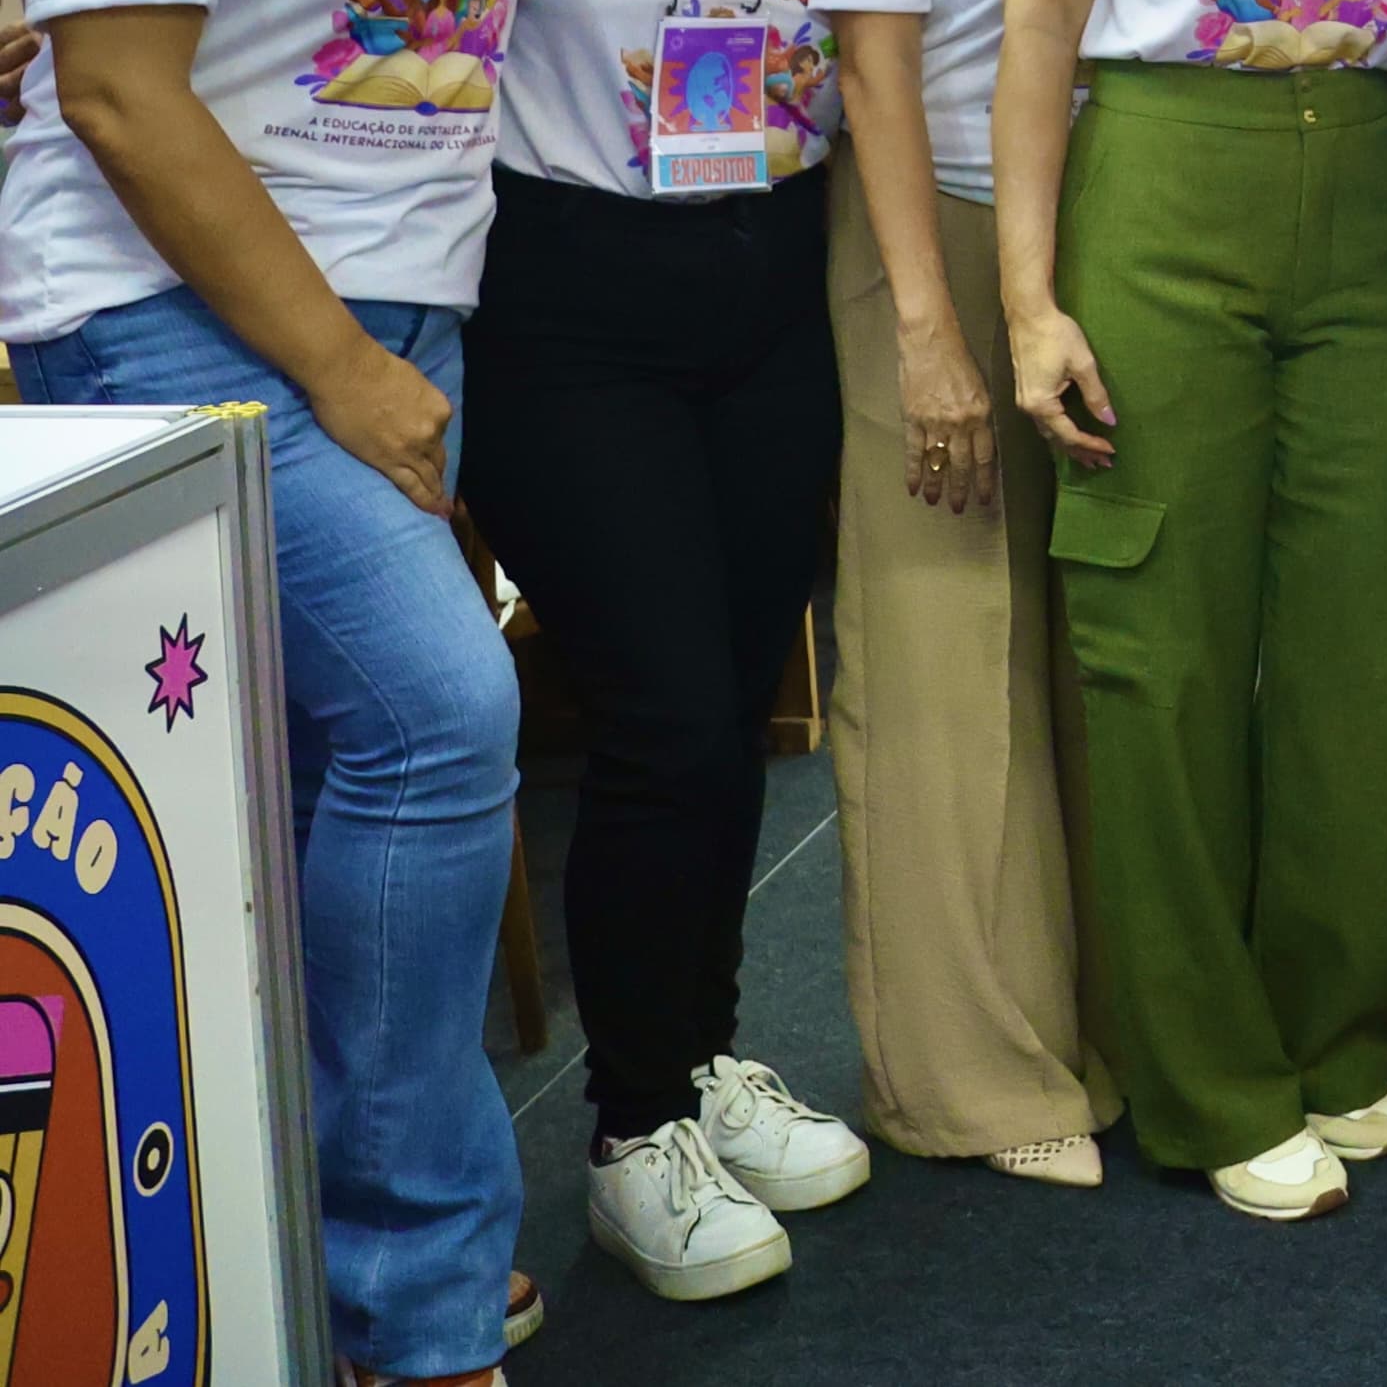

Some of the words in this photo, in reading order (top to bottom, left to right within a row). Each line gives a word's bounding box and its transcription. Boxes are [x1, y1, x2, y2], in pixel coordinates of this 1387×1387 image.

[264, 123, 318, 142] BIENAL
[323, 132, 427, 150] INTERNACIONAL
[309, 117, 317, 126] A
[322, 117, 395, 135] EDUCAÇÃO
[398, 125, 414, 134] DE
[671, 155, 757, 186] EXPOSITOR
